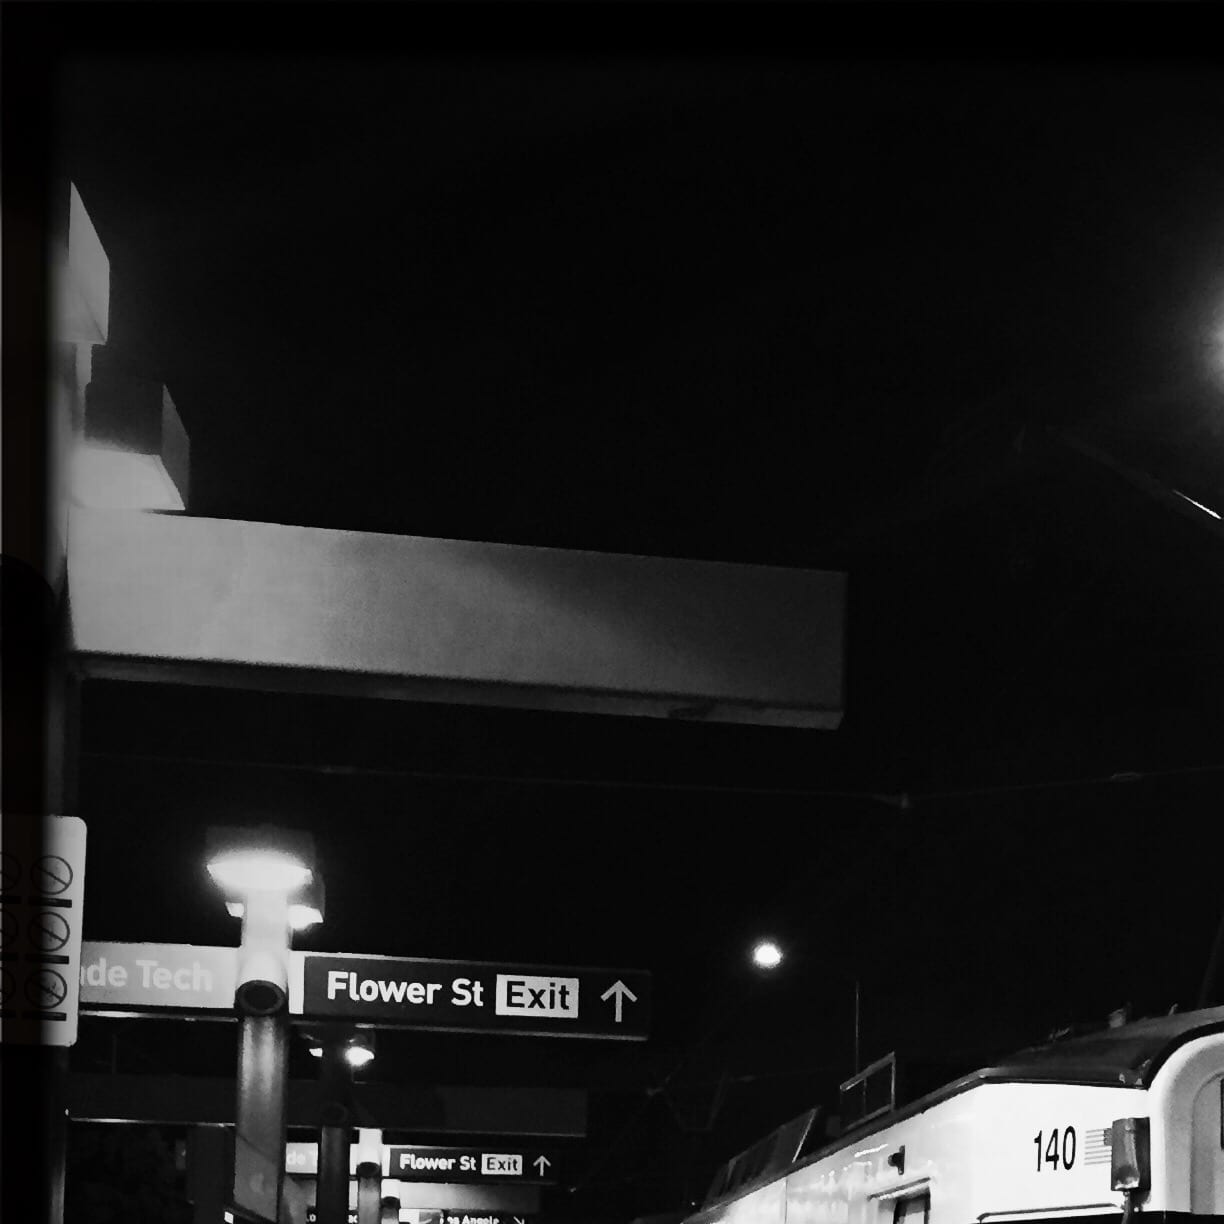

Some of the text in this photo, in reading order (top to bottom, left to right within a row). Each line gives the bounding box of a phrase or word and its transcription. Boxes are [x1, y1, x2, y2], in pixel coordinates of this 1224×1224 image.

[80, 957, 213, 992] de Tech
[327, 970, 570, 1010] Flower St Exit
[400, 1153, 520, 1172] Flower St Exit
[1033, 1125, 1077, 1172] 140
